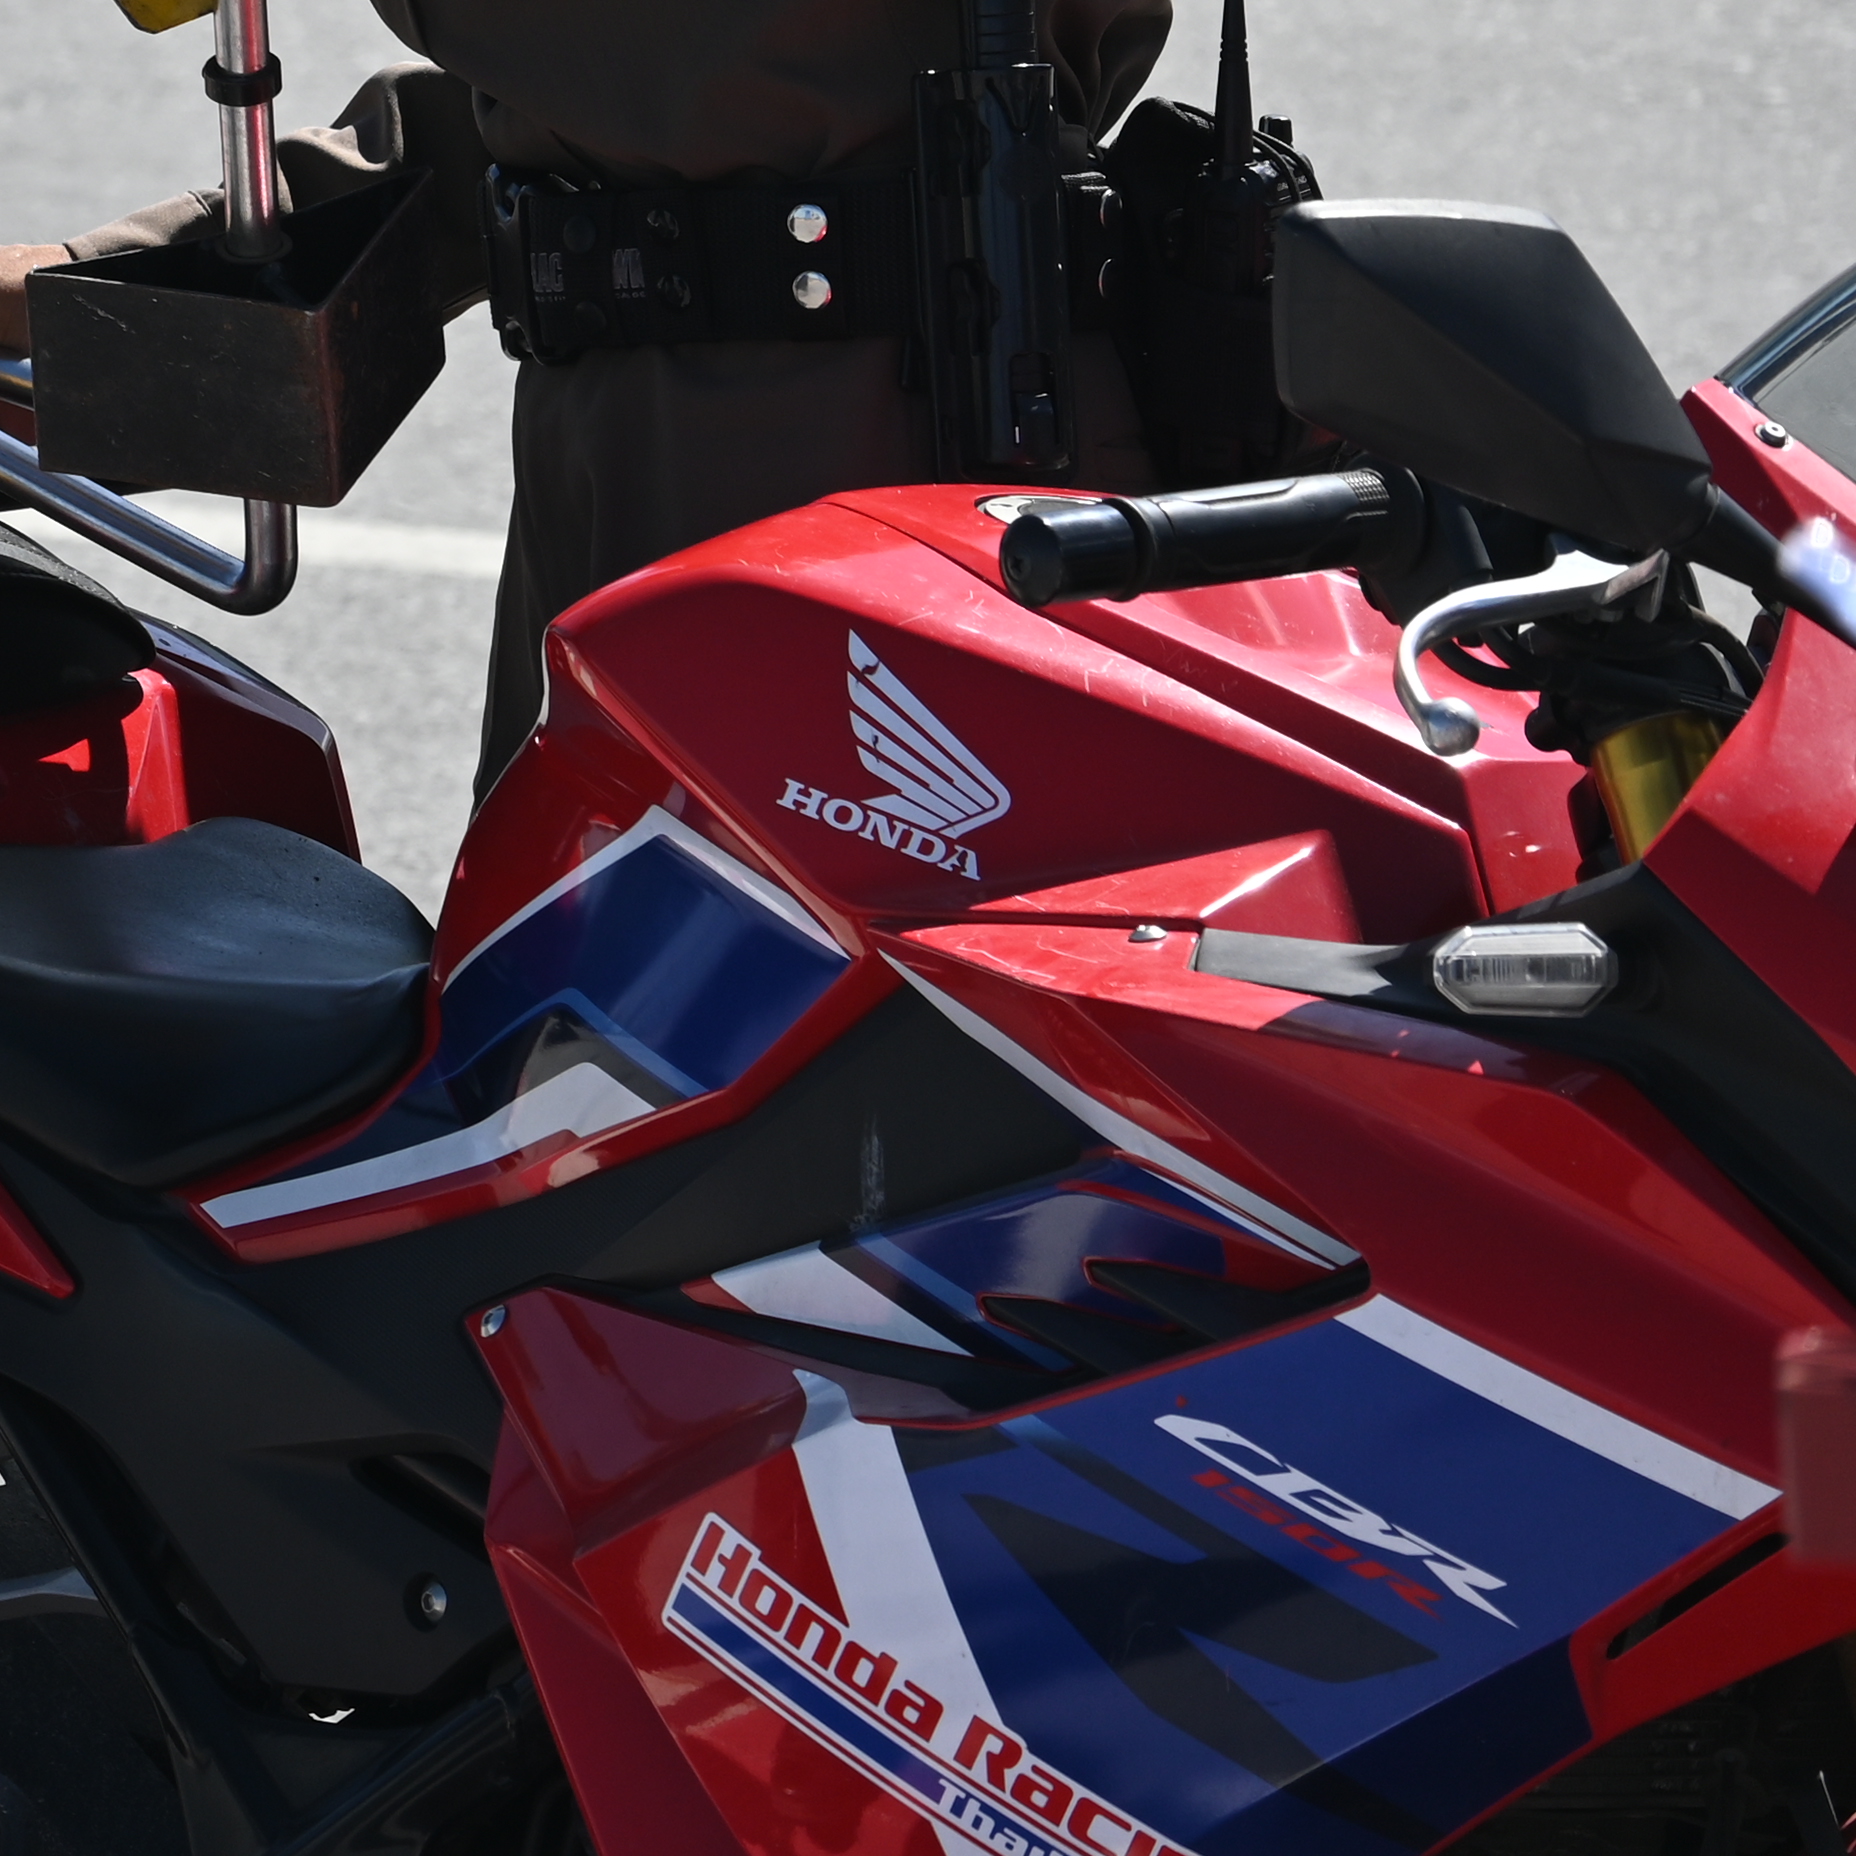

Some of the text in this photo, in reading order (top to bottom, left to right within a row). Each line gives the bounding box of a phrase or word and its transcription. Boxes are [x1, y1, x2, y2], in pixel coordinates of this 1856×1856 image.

[775, 777, 982, 882] HONDA
[1153, 1413, 1520, 1630] CBR
[1191, 1469, 1444, 1621] 150R
[689, 1520, 944, 1744] Honda
